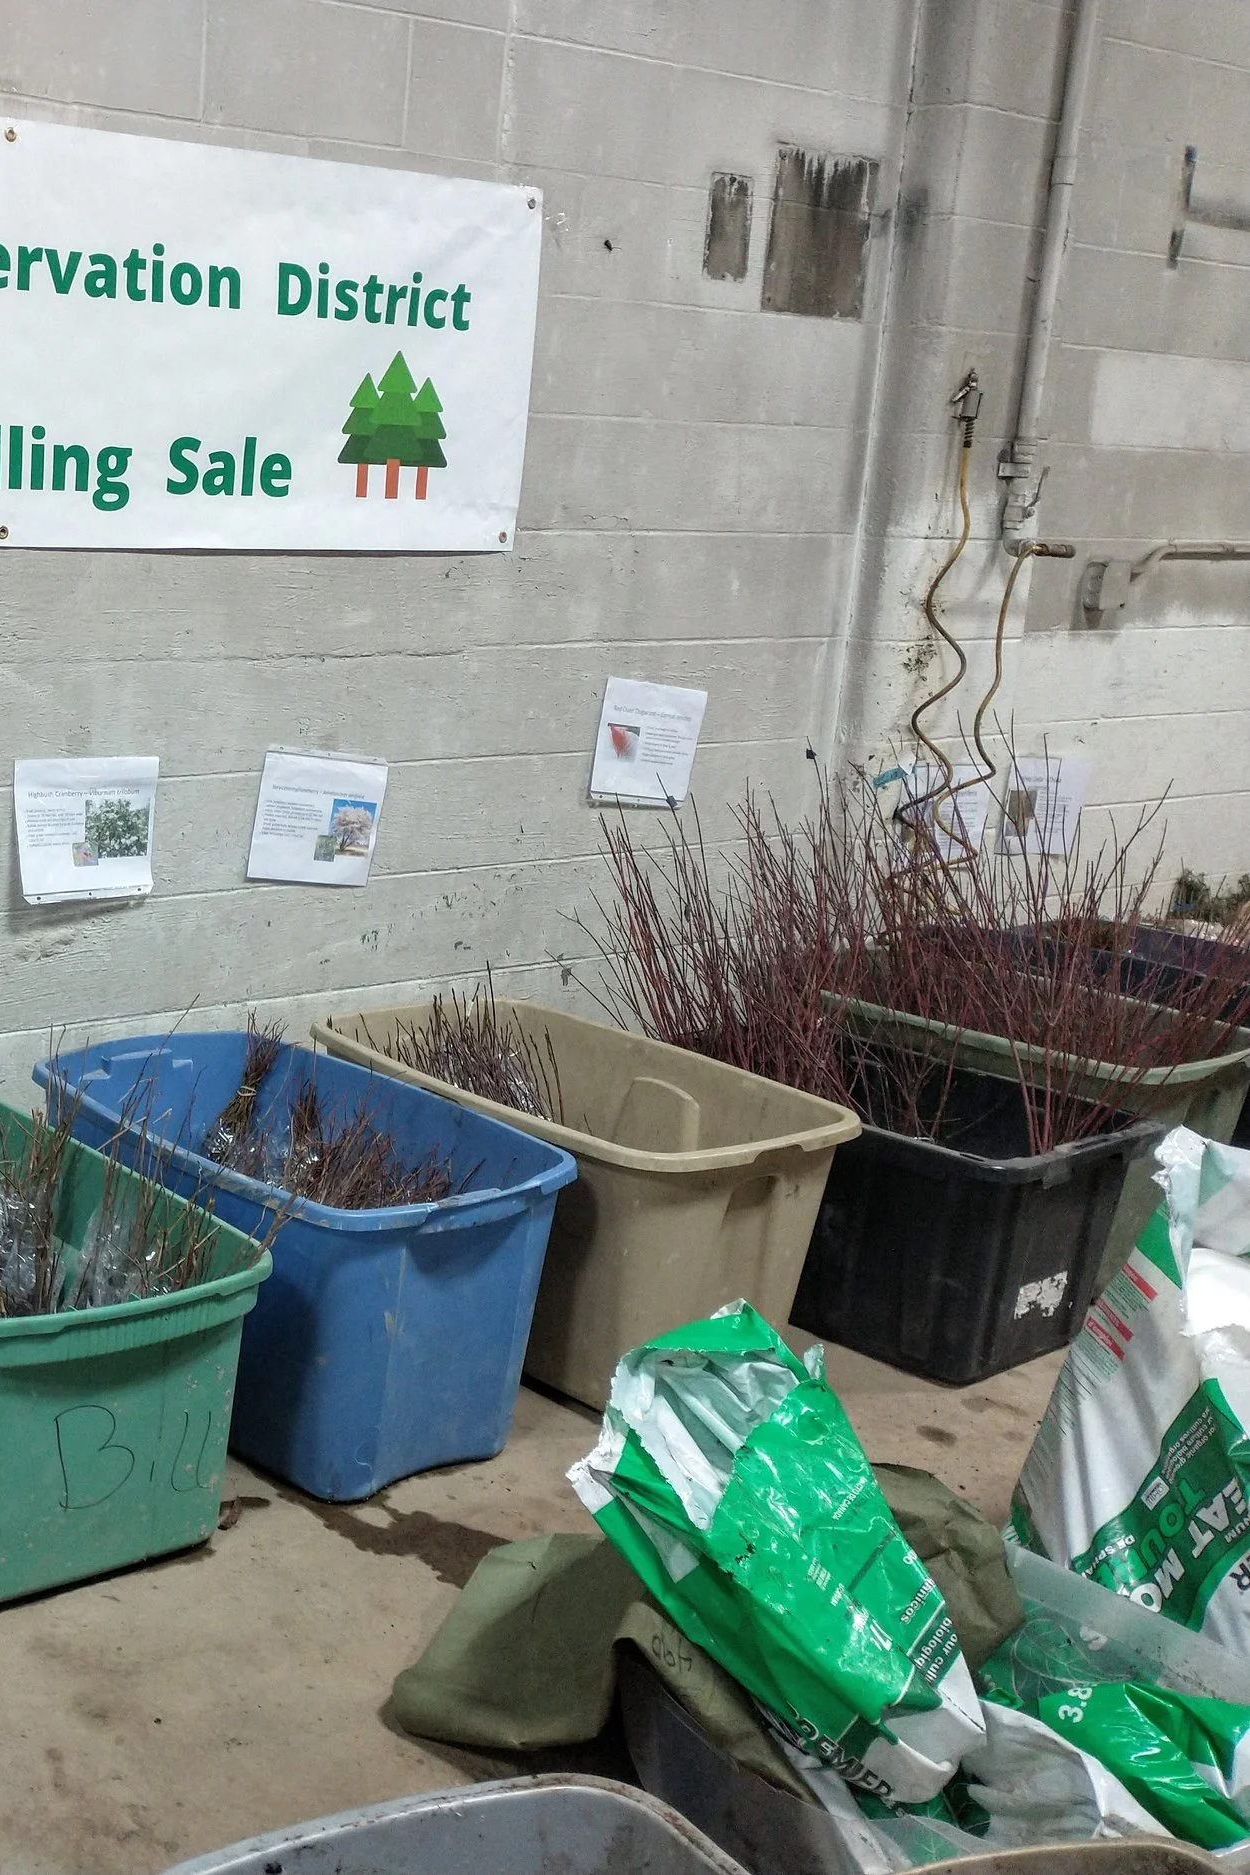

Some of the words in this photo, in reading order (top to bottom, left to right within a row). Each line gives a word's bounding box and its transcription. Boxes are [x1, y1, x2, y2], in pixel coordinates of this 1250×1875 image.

[277, 261, 472, 332] District
[166, 436, 293, 498] Sale
[54, 1404, 211, 1511] Bill
